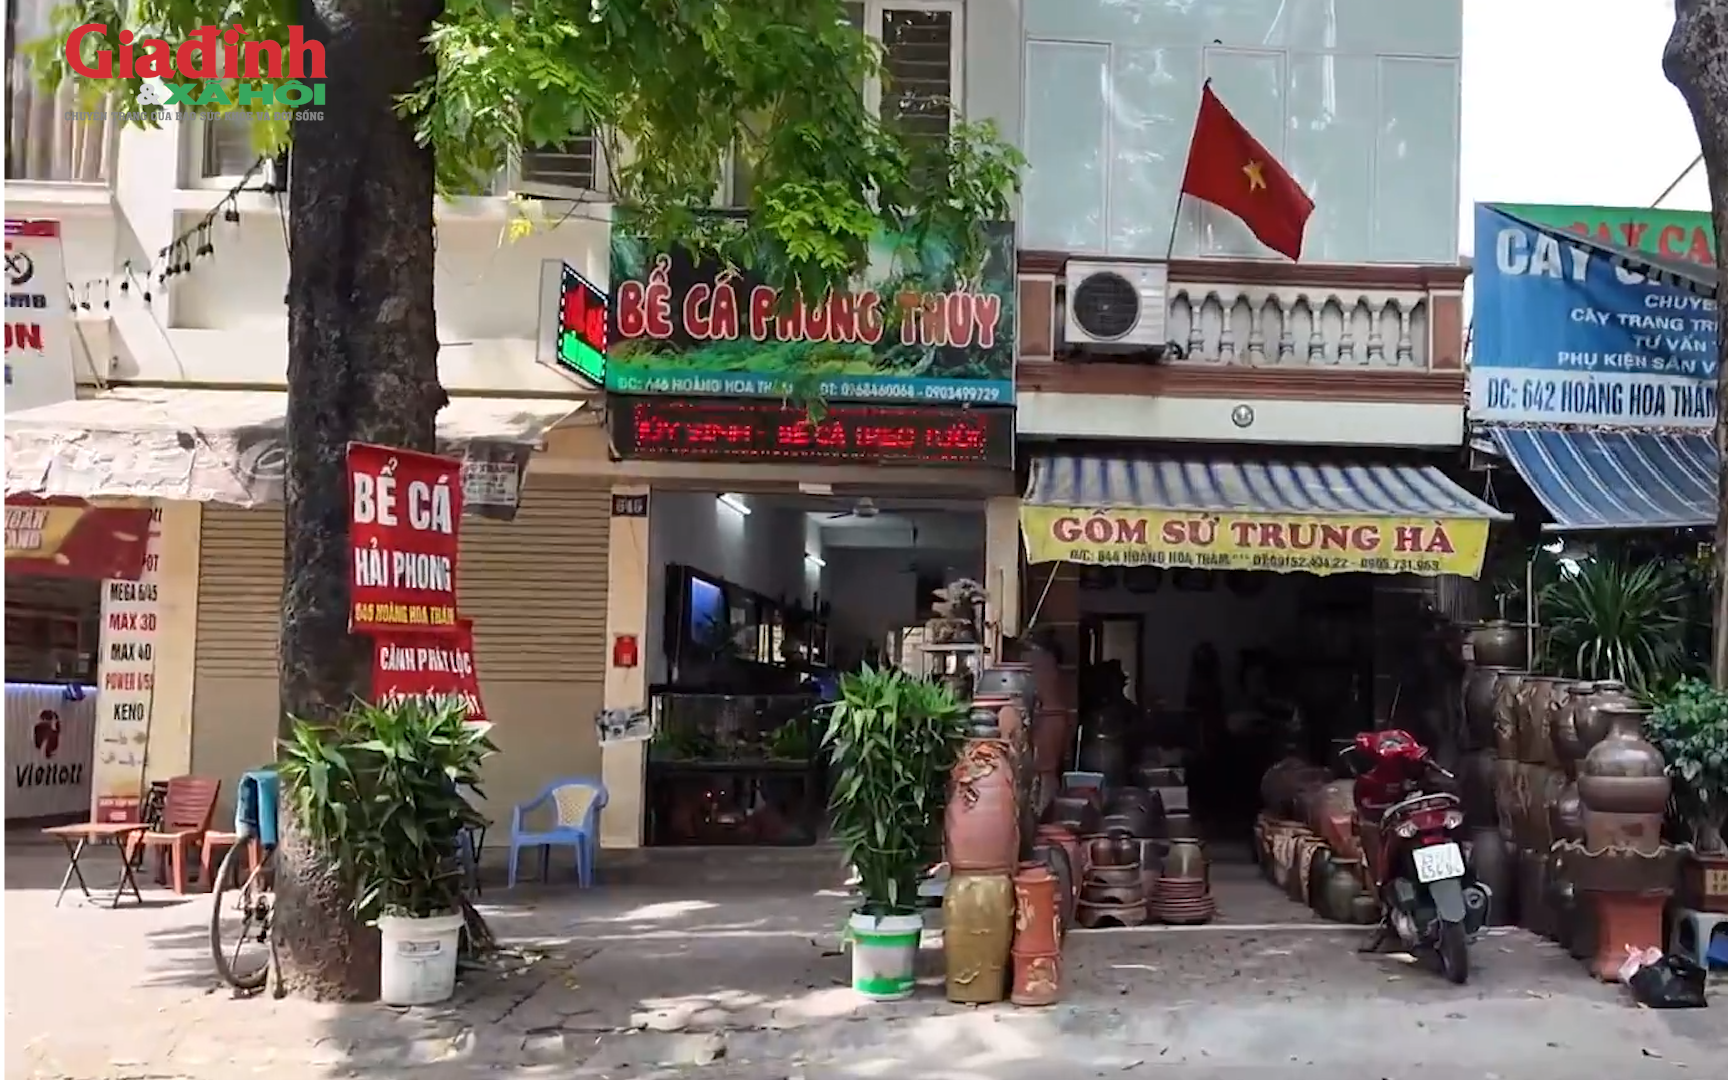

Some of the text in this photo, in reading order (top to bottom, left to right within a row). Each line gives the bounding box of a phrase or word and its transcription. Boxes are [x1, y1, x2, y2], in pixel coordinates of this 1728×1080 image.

[617, 253, 674, 339] BỂ
[683, 268, 739, 340] CÁ
[1570, 307, 1611, 326] CÂY
[1617, 313, 1684, 331] TRANG
[1666, 333, 1707, 352] VẤN
[1558, 351, 1598, 371] PHỤ
[1604, 352, 1648, 371] KIỆN
[672, 375, 723, 394] HOÀNG
[724, 379, 755, 394] HOA
[1523, 378, 1556, 412] 642
[1561, 375, 1624, 416] HOÀNG
[1630, 383, 1666, 417] HOA
[353, 457, 398, 526] BỂ
[408, 474, 452, 534] CÁ
[1053, 508, 1455, 553] GỐM SỨ TRUNG HÀ
[355, 537, 388, 587] HẢI
[110, 583, 136, 602] MEGA
[109, 613, 157, 631] MAX 3D
[111, 643, 135, 661] MAX
[380, 642, 416, 671] CẢNH
[450, 648, 472, 678] LỘC
[105, 672, 135, 691] POWER
[113, 703, 144, 721] KENO
